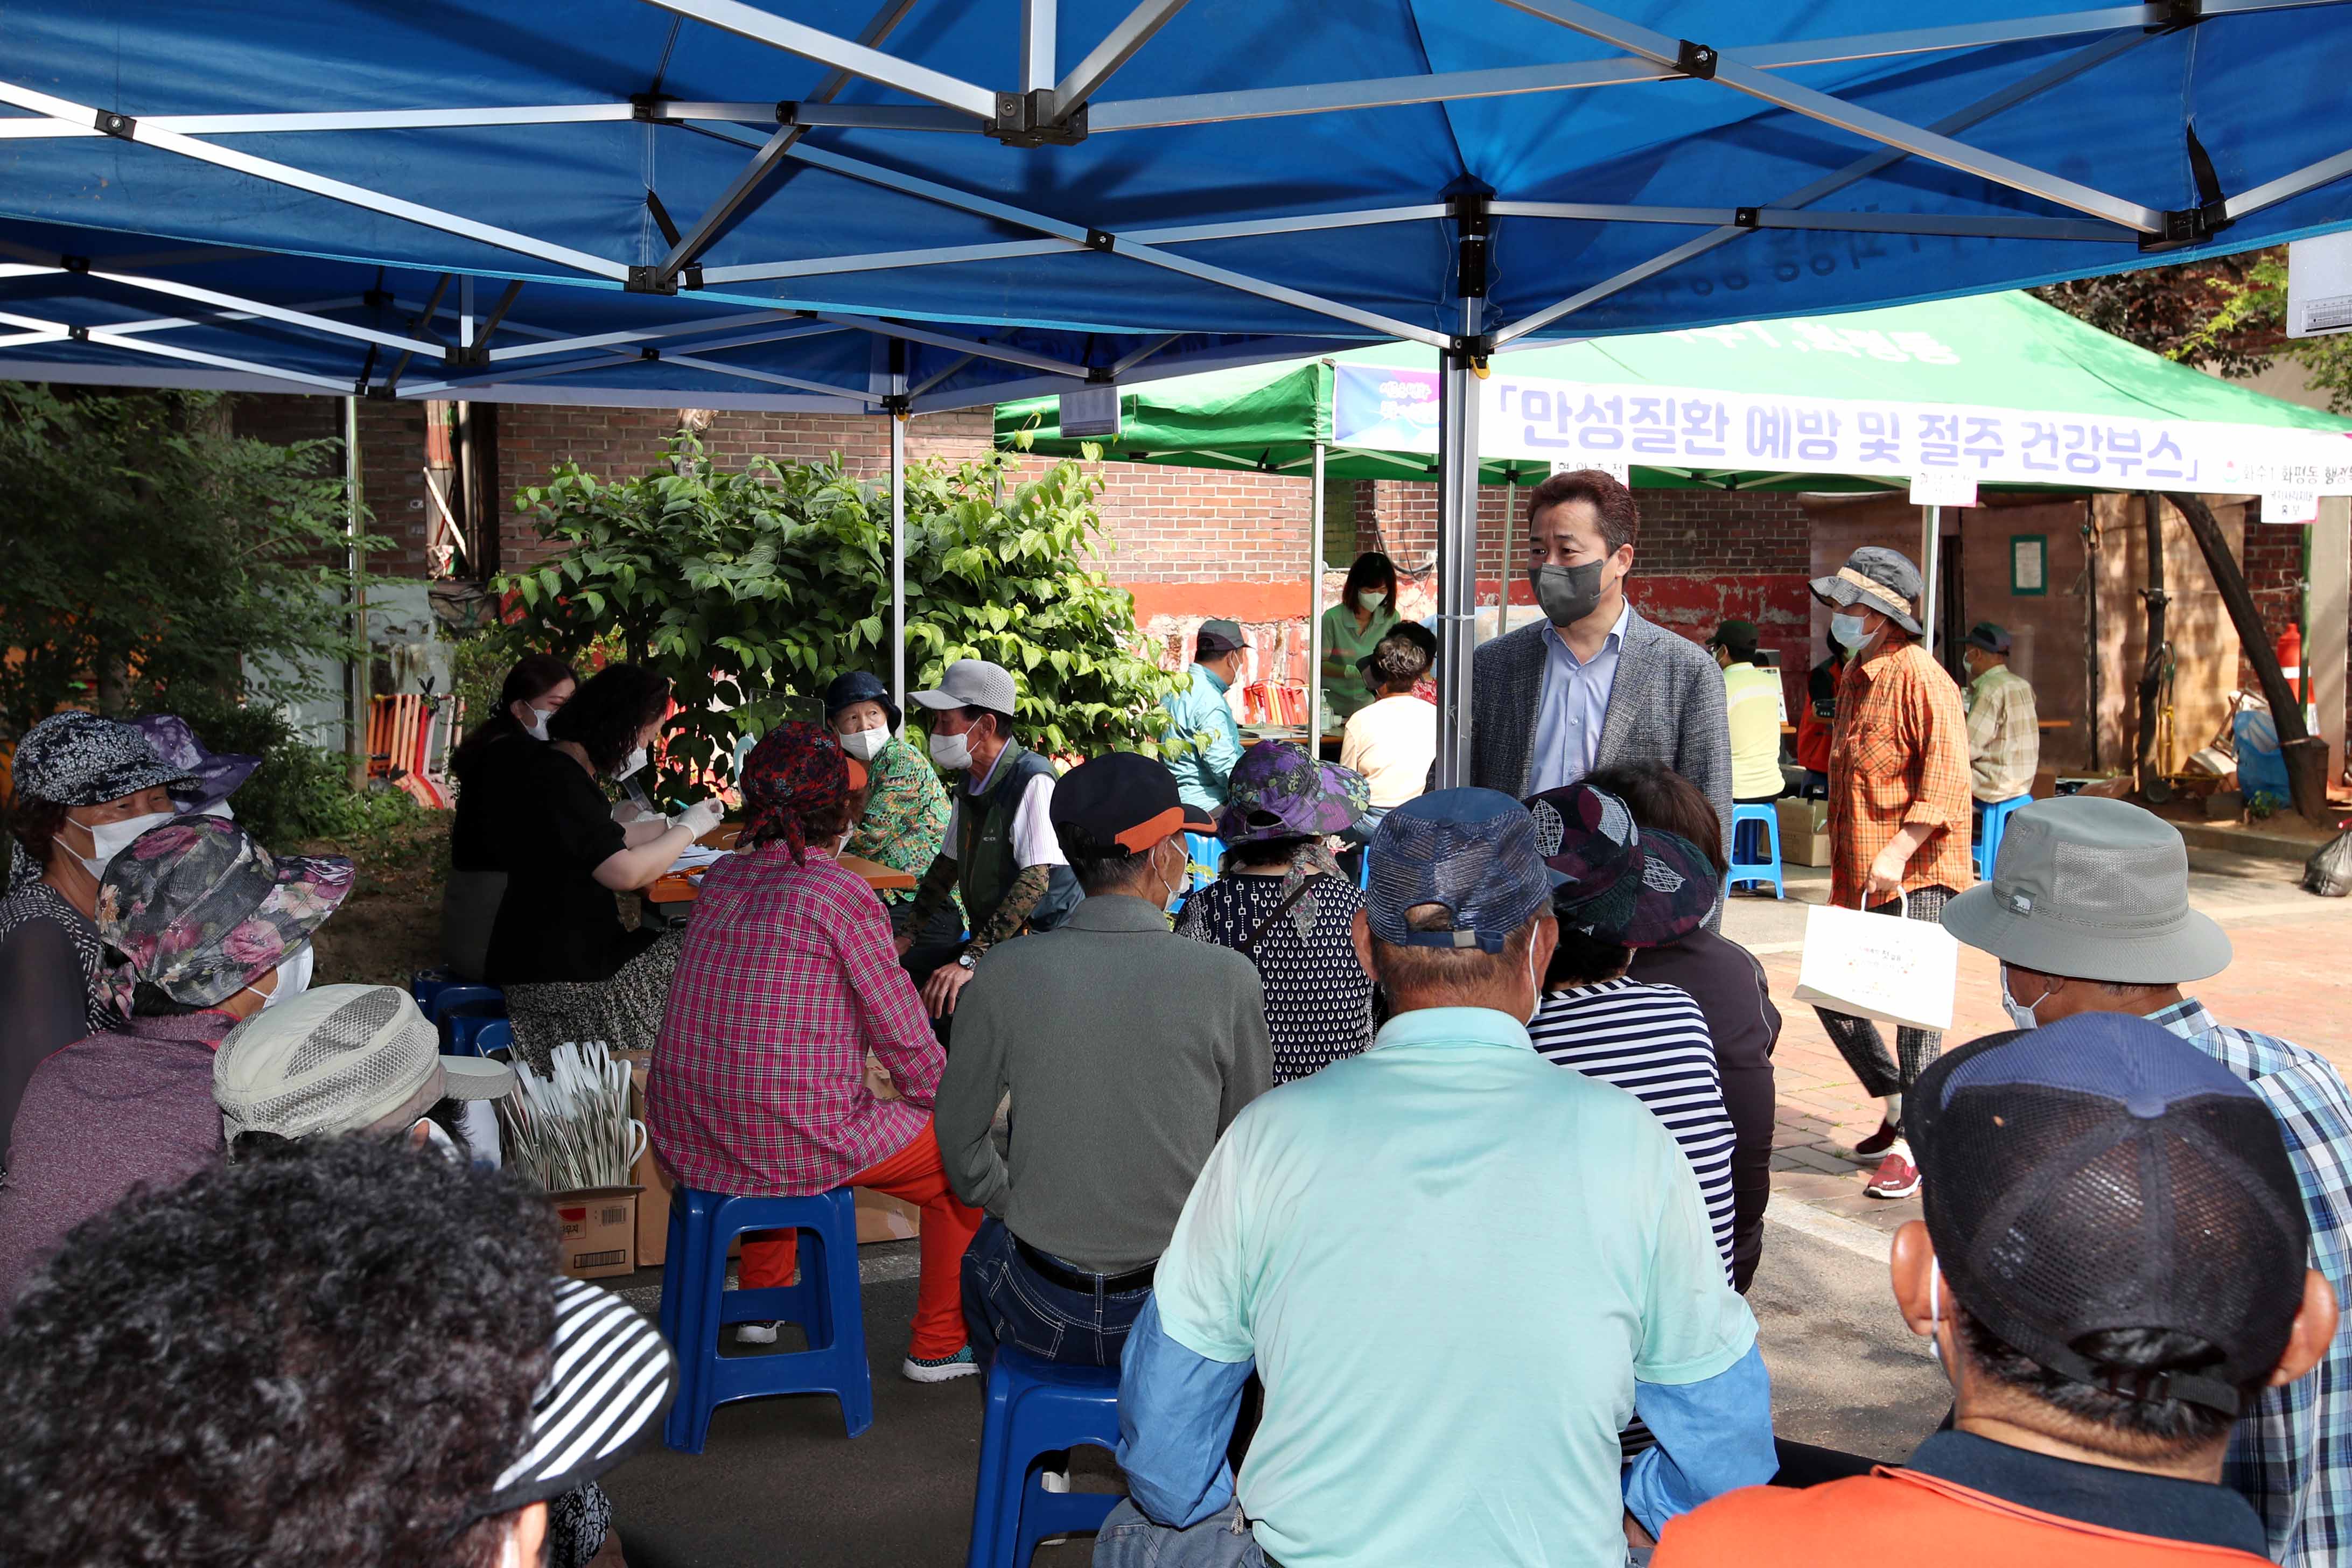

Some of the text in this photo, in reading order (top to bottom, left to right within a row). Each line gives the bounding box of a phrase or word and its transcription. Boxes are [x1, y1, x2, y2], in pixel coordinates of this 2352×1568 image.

[1746, 407, 1842, 461] 예방
[1858, 412, 1901, 464] 및
[1918, 414, 2005, 469] 절주
